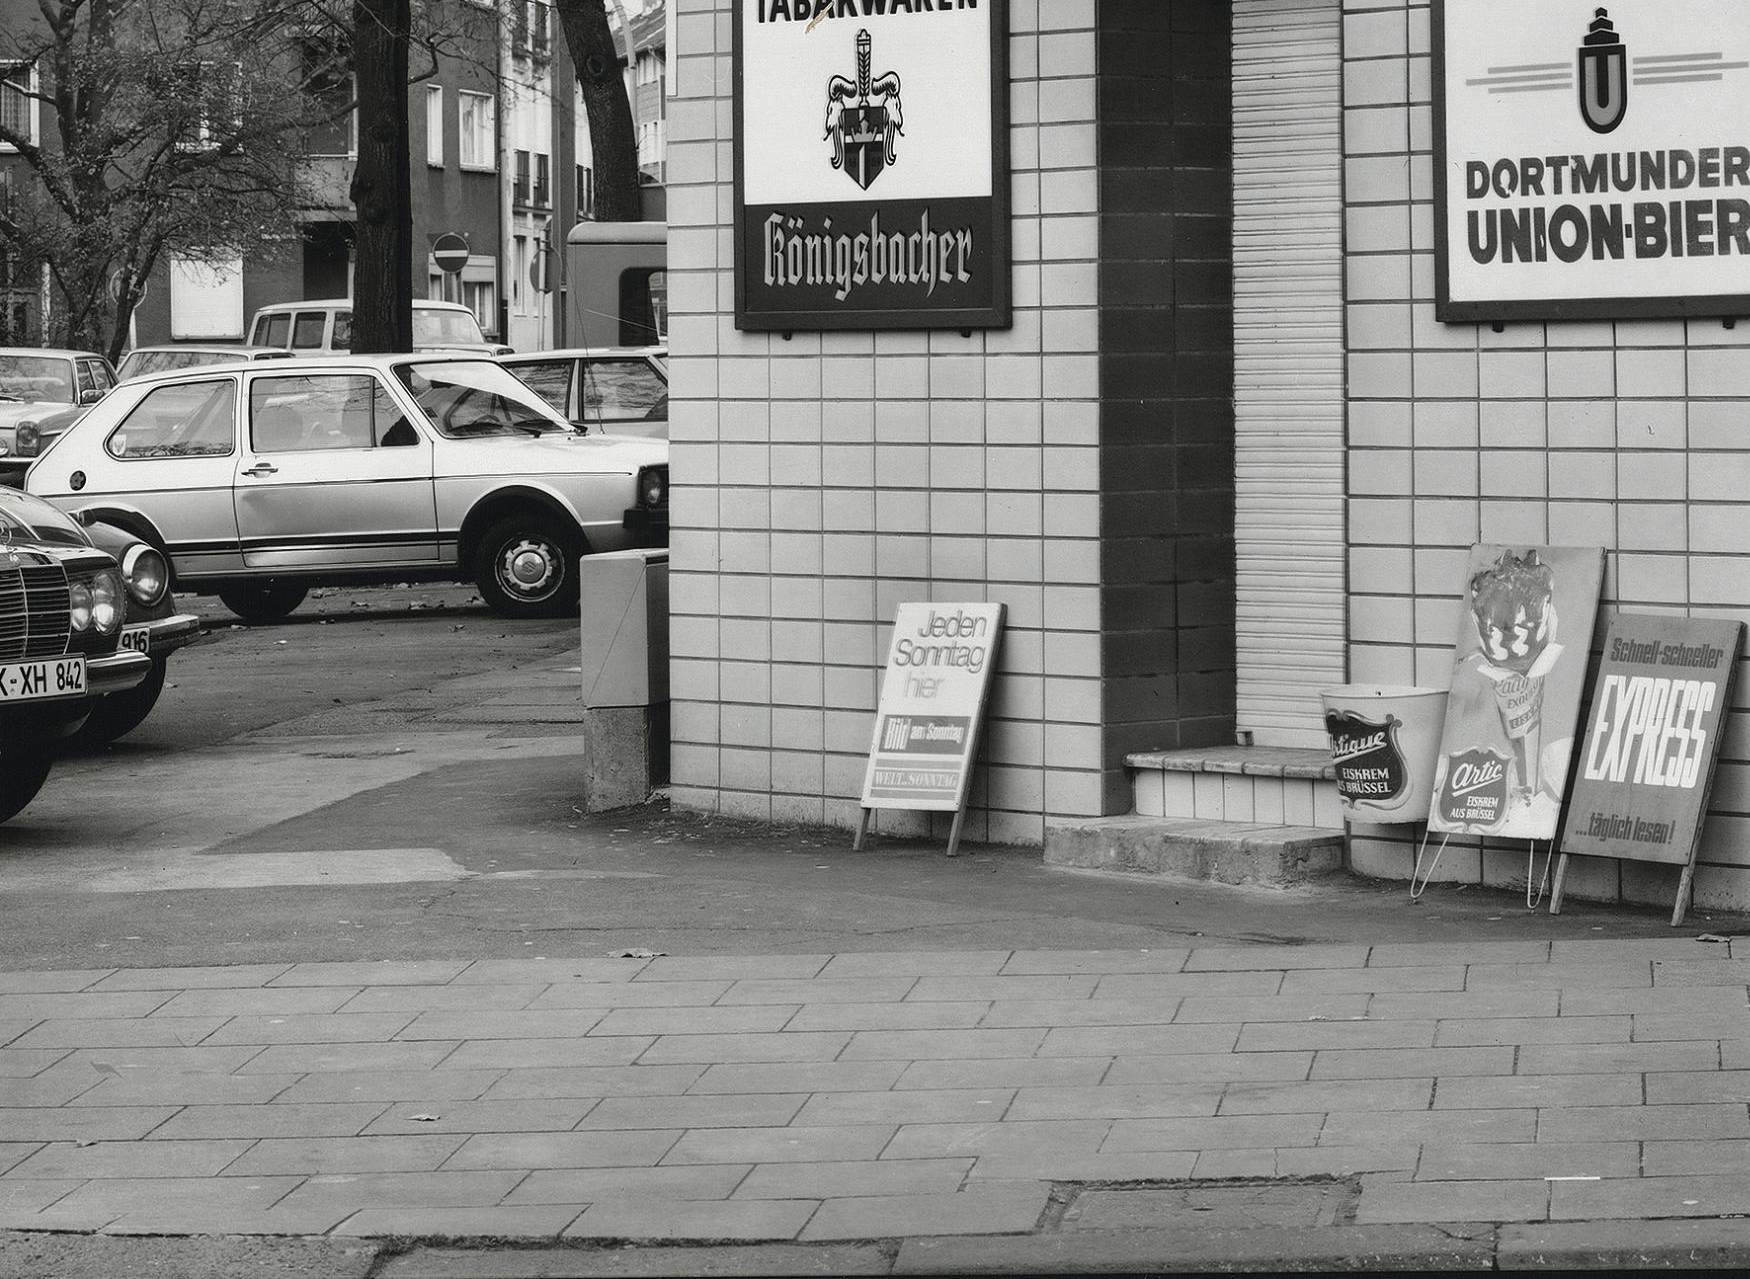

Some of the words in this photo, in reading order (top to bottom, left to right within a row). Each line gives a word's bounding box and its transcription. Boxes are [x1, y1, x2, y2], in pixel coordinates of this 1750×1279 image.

[1466, 146, 1750, 200] DORTMUNDER
[763, 208, 972, 301] Königsbacher
[918, 609, 987, 638] Jeden
[122, 631, 148, 653] 916
[1610, 637, 1724, 669] Schnell-schneller
[894, 639, 986, 674] Sonntag
[56, 661, 82, 691] 842
[905, 670, 945, 698] hier
[883, 717, 912, 751] Bild
[926, 723, 964, 743] Sonntag
[1584, 675, 1716, 789] EXPRESS
[875, 771, 902, 786] WELT
[908, 773, 959, 788] SONNTAG
[1342, 767, 1389, 780] EISKREM
[1346, 781, 1392, 793] BRÜSSEL
[1450, 807, 1466, 818] AUS
[1466, 806, 1495, 820] BRÜSSEL
[1466, 795, 1499, 808] EISKREM
[1633, 817, 1676, 844] lesen!
